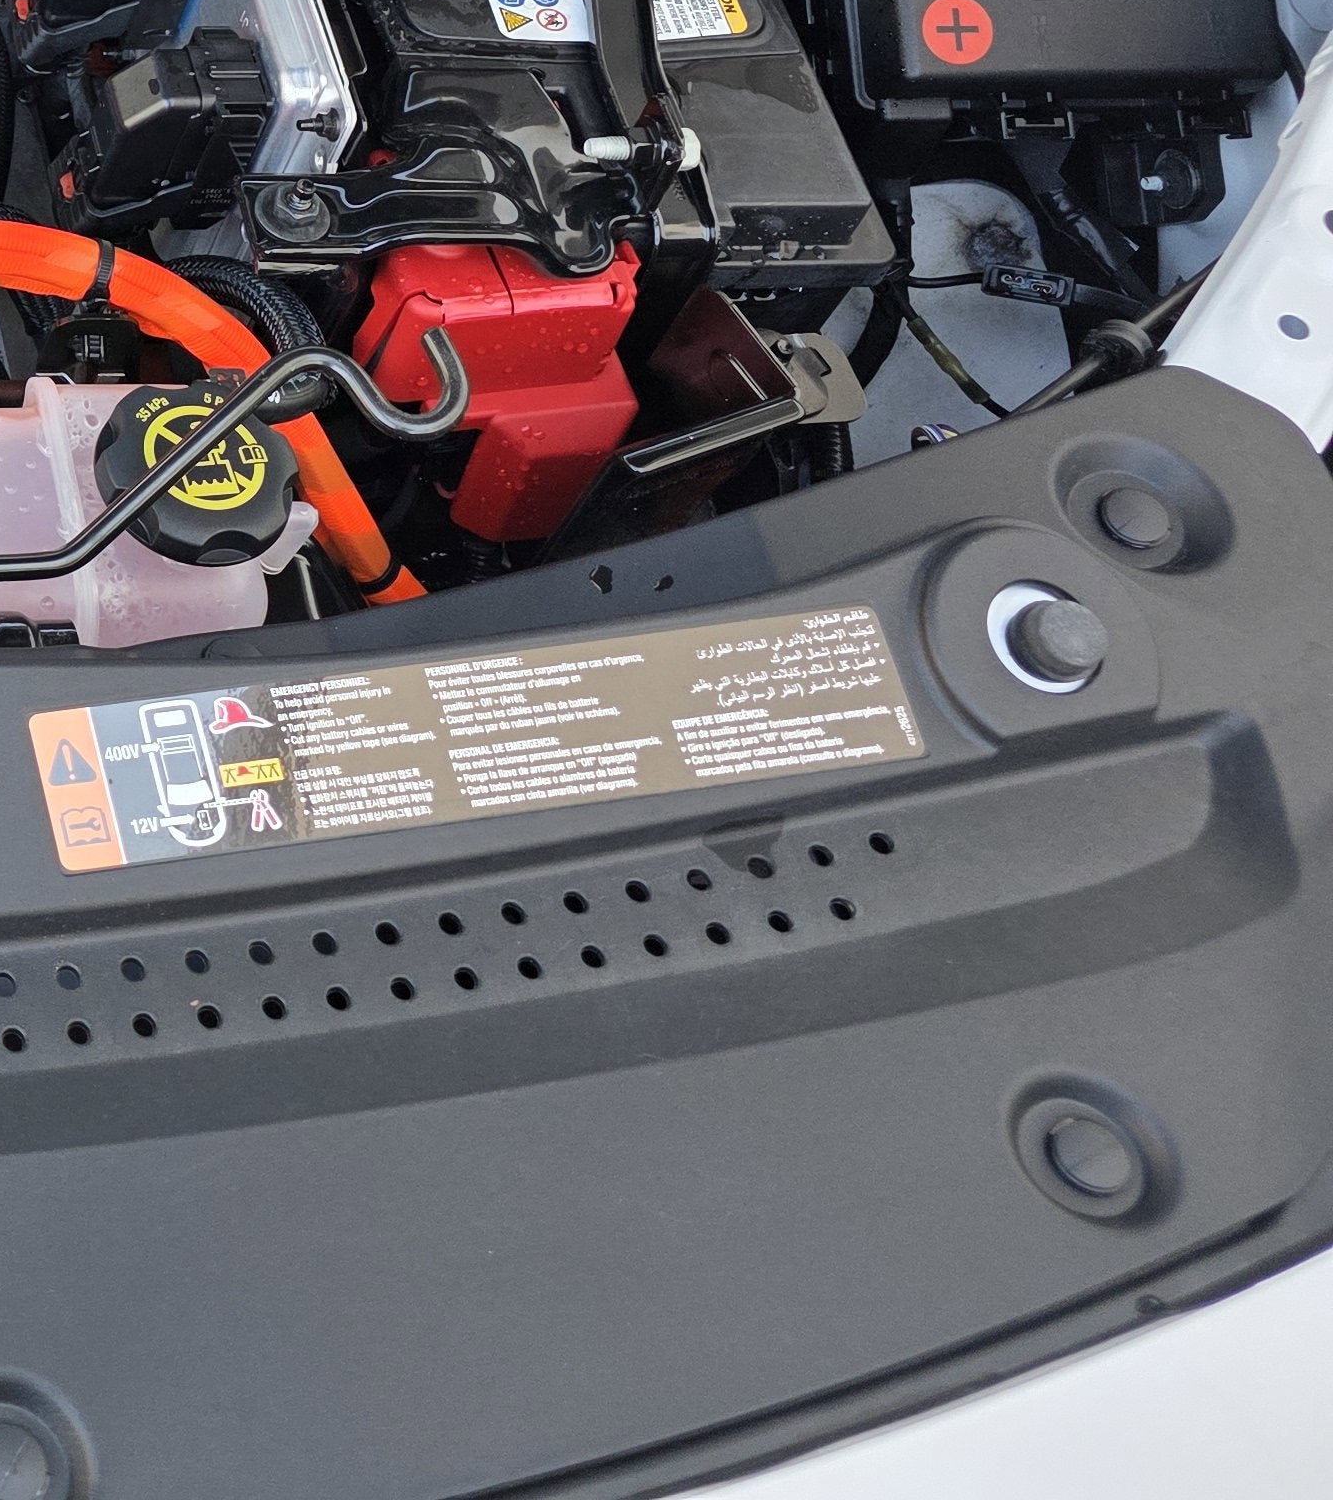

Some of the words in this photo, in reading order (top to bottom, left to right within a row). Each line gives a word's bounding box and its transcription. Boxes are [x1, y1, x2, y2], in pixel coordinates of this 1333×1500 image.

[202, 392, 212, 403] 5
[135, 408, 151, 422] 35
[145, 394, 169, 414] kPa
[104, 744, 140, 762] 400V
[130, 817, 159, 836] 12V
